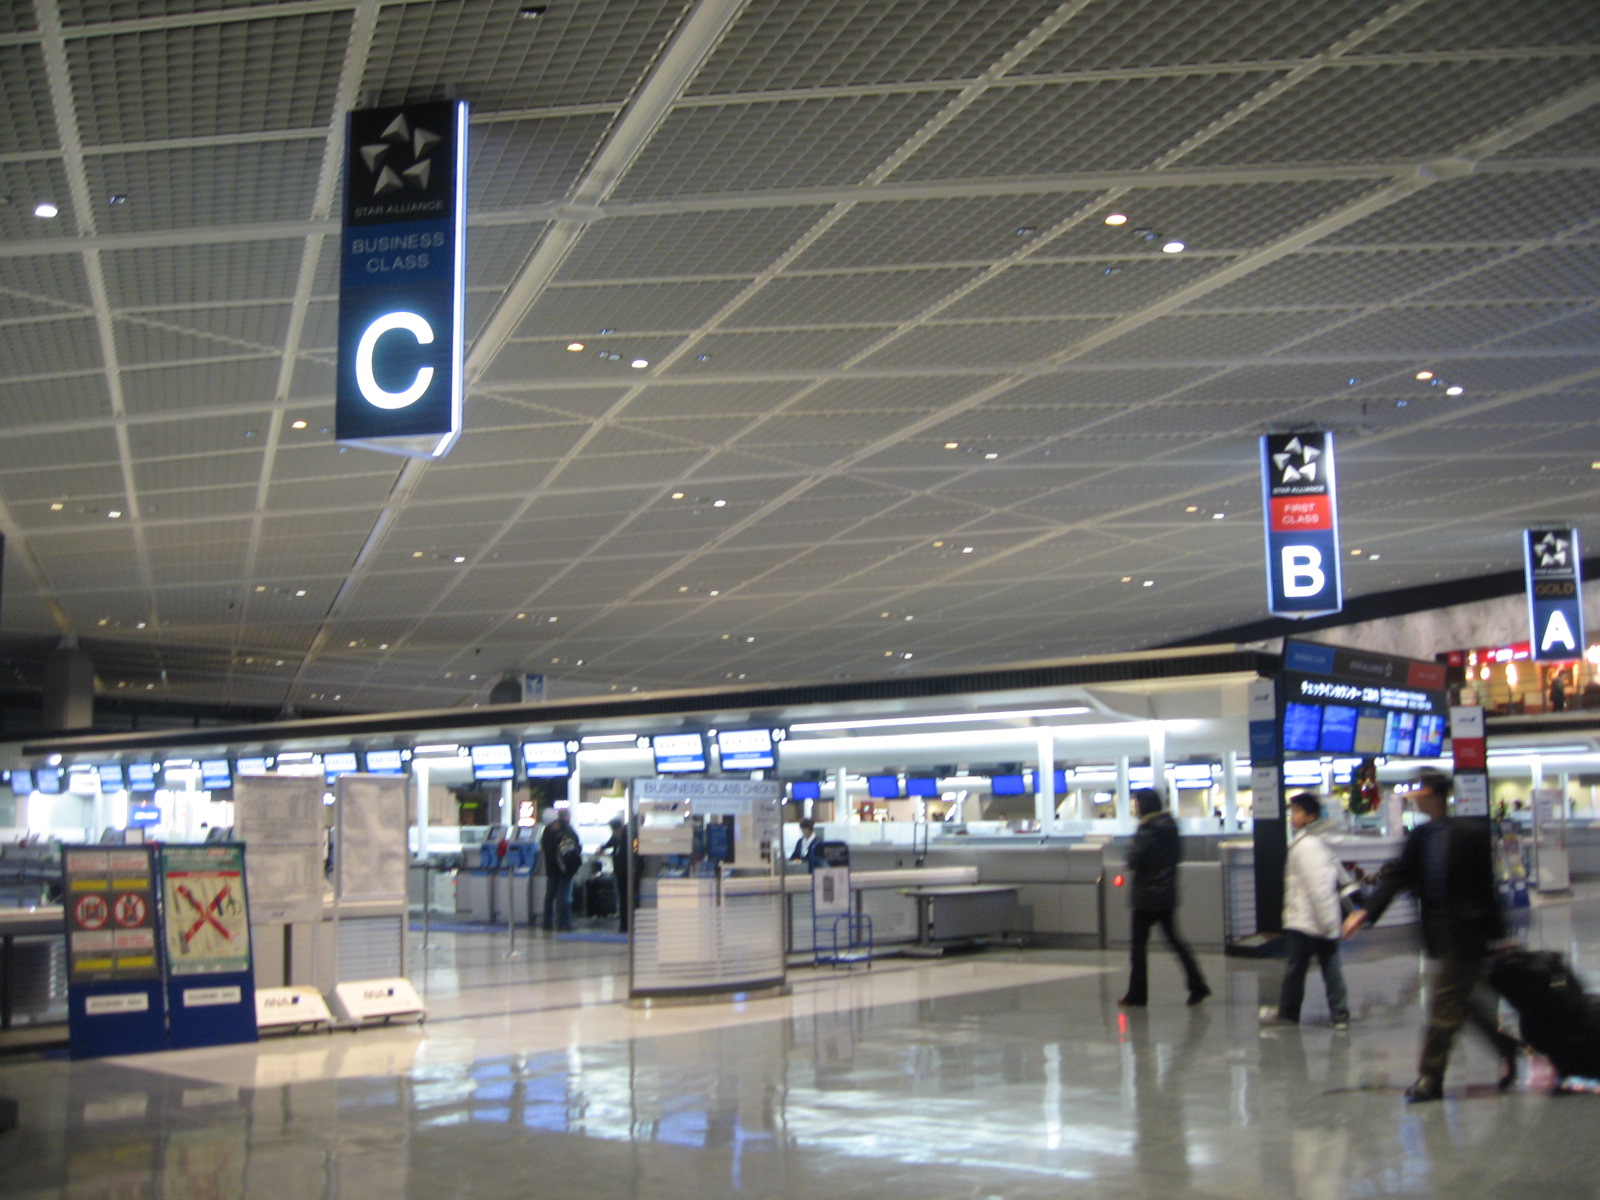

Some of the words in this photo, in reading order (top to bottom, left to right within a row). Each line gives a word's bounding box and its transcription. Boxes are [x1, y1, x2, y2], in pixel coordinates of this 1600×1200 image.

[354, 206, 384, 217] STAR
[385, 200, 443, 214] ALLIANCE
[352, 231, 444, 254] BUSINESS
[366, 253, 429, 273] CLASS
[355, 311, 434, 410] C
[1284, 502, 1315, 513] FIRST
[1282, 513, 1320, 525] CLASS
[1282, 545, 1325, 597] B
[1535, 582, 1574, 595] GOLD
[1541, 609, 1575, 651] A
[644, 782, 705, 794] BUSINESS
[706, 782, 741, 793] CLASS
